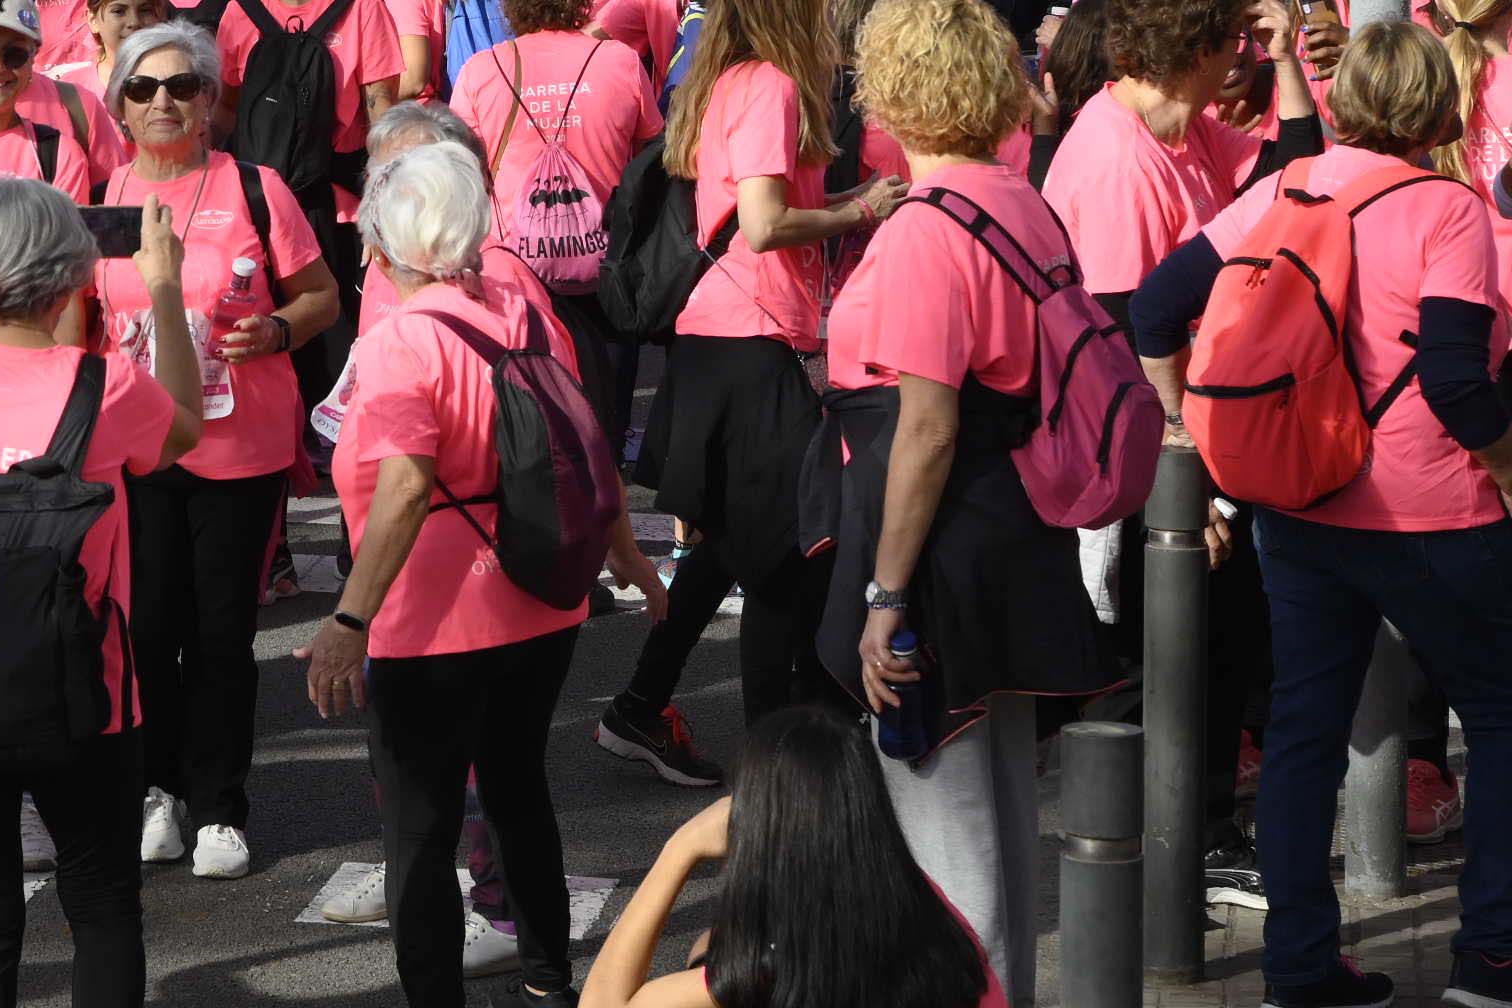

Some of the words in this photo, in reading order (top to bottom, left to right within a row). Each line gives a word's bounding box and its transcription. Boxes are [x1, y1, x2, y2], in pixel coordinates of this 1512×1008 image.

[529, 101, 551, 114] DE
[557, 99, 577, 112] LA
[526, 115, 582, 130] MUJER
